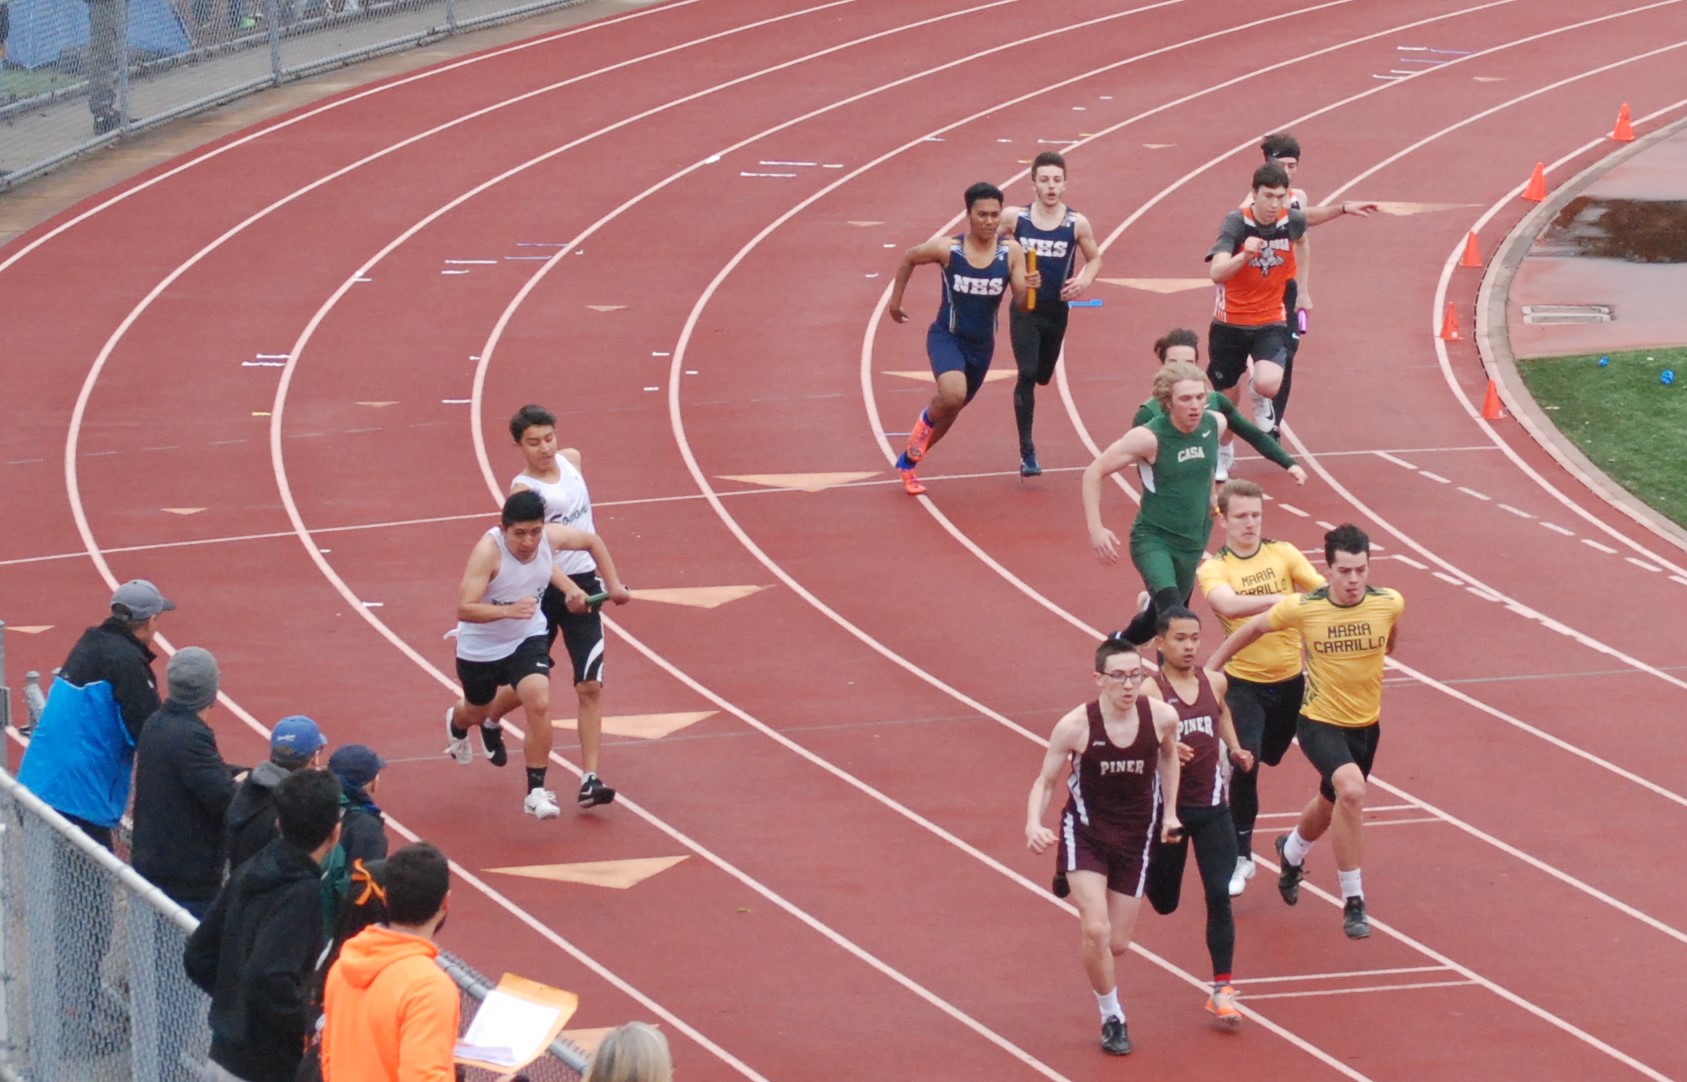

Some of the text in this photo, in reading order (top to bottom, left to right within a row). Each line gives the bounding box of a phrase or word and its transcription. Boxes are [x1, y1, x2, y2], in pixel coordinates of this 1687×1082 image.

[1020, 237, 1068, 257] NHS
[953, 274, 1003, 295] NHS
[1177, 446, 1205, 462] CASA
[1241, 567, 1276, 588] MARIA
[1327, 623, 1372, 639] MARIA
[1313, 635, 1386, 654] CARRILLO
[1175, 715, 1214, 742] PINER
[1100, 759, 1145, 776] PINER
